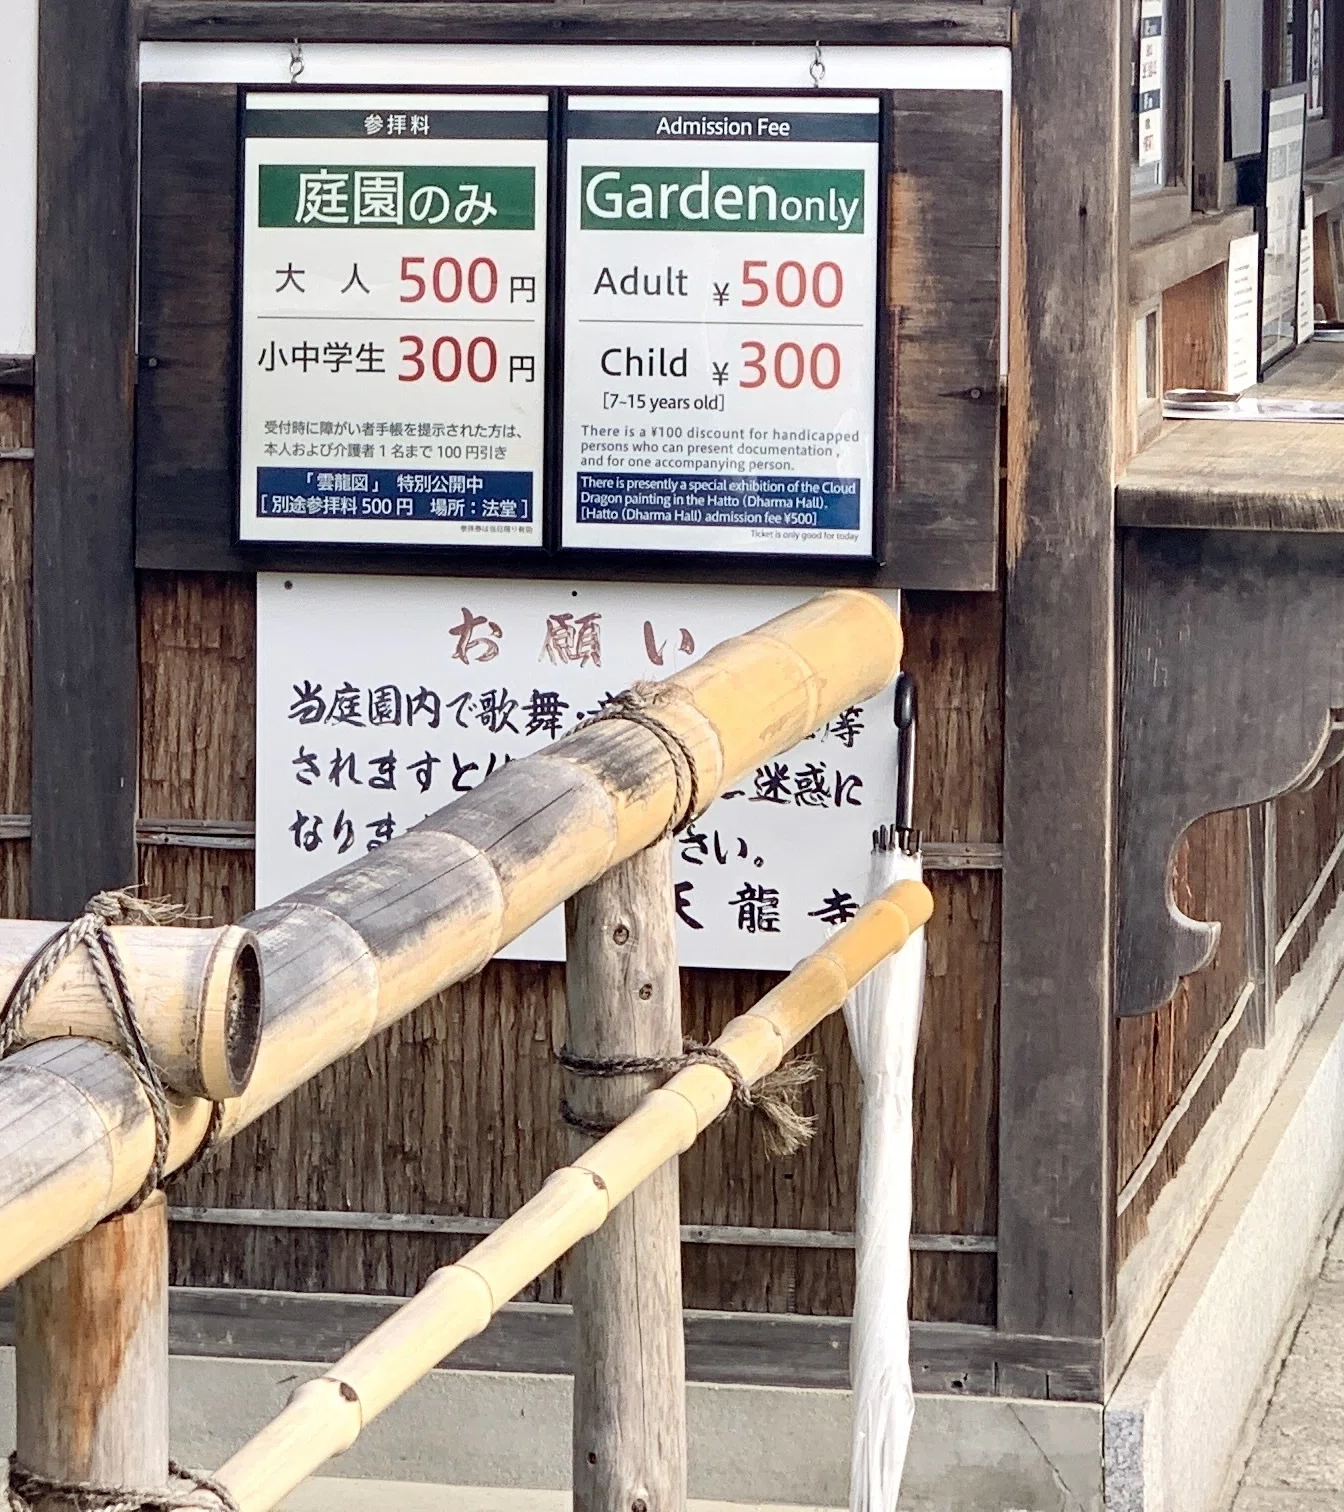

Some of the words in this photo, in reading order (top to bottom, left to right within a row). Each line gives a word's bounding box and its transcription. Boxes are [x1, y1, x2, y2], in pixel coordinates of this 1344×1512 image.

[364, 114, 430, 135] 参拝料
[656, 116, 752, 135] Admission
[758, 118, 790, 136] Fee
[295, 169, 497, 225] 庭園のみ
[586, 170, 776, 221] Garden
[781, 188, 859, 231] only
[593, 266, 688, 296] Adult
[257, 341, 385, 373] 小中学生
[602, 348, 687, 377] Child
[650, 396, 690, 413] years
[694, 394, 725, 411] old]
[582, 426, 620, 437] There
[652, 427, 682, 438] ¥100
[687, 428, 744, 440] discount
[750, 429, 768, 440] for
[773, 429, 859, 443] handicapped
[582, 442, 628, 454] persons
[632, 442, 658, 453] who
[662, 444, 684, 453] can
[687, 444, 733, 457] present
[581, 456, 604, 467] and
[608, 456, 624, 467] for
[628, 458, 651, 468] one
[655, 458, 745, 472] accompanying
[749, 462, 795, 473] person.
[397, 474, 483, 494] 特別公開中
[581, 477, 614, 489] There
[627, 478, 678, 492] presently
[689, 479, 727, 493] special
[729, 480, 785, 492] exhibition
[787, 482, 799, 493] of
[801, 482, 820, 493] the
[822, 482, 856, 494] Cloud
[582, 492, 622, 506] Dragon
[625, 494, 671, 508] painting
[673, 495, 685, 506] in
[687, 496, 705, 507] the
[708, 496, 739, 508] Hatto
[743, 496, 793, 509] (Dharma
[796, 497, 827, 510] Hall).
[582, 508, 618, 521] [Hatto
[622, 509, 672, 522] (Dharma
[675, 510, 702, 522] Hall)
[705, 511, 761, 523] admission
[764, 512, 782, 523] fee
[784, 512, 817, 525] ¥500]
[752, 530, 773, 539] Ticket
[783, 530, 800, 541] only
[802, 531, 822, 541] good
[824, 532, 835, 540] for
[837, 532, 859, 542] today
[287, 682, 616, 740] 当庭園内で歌舞・
[721, 762, 863, 808] 迷惑に
